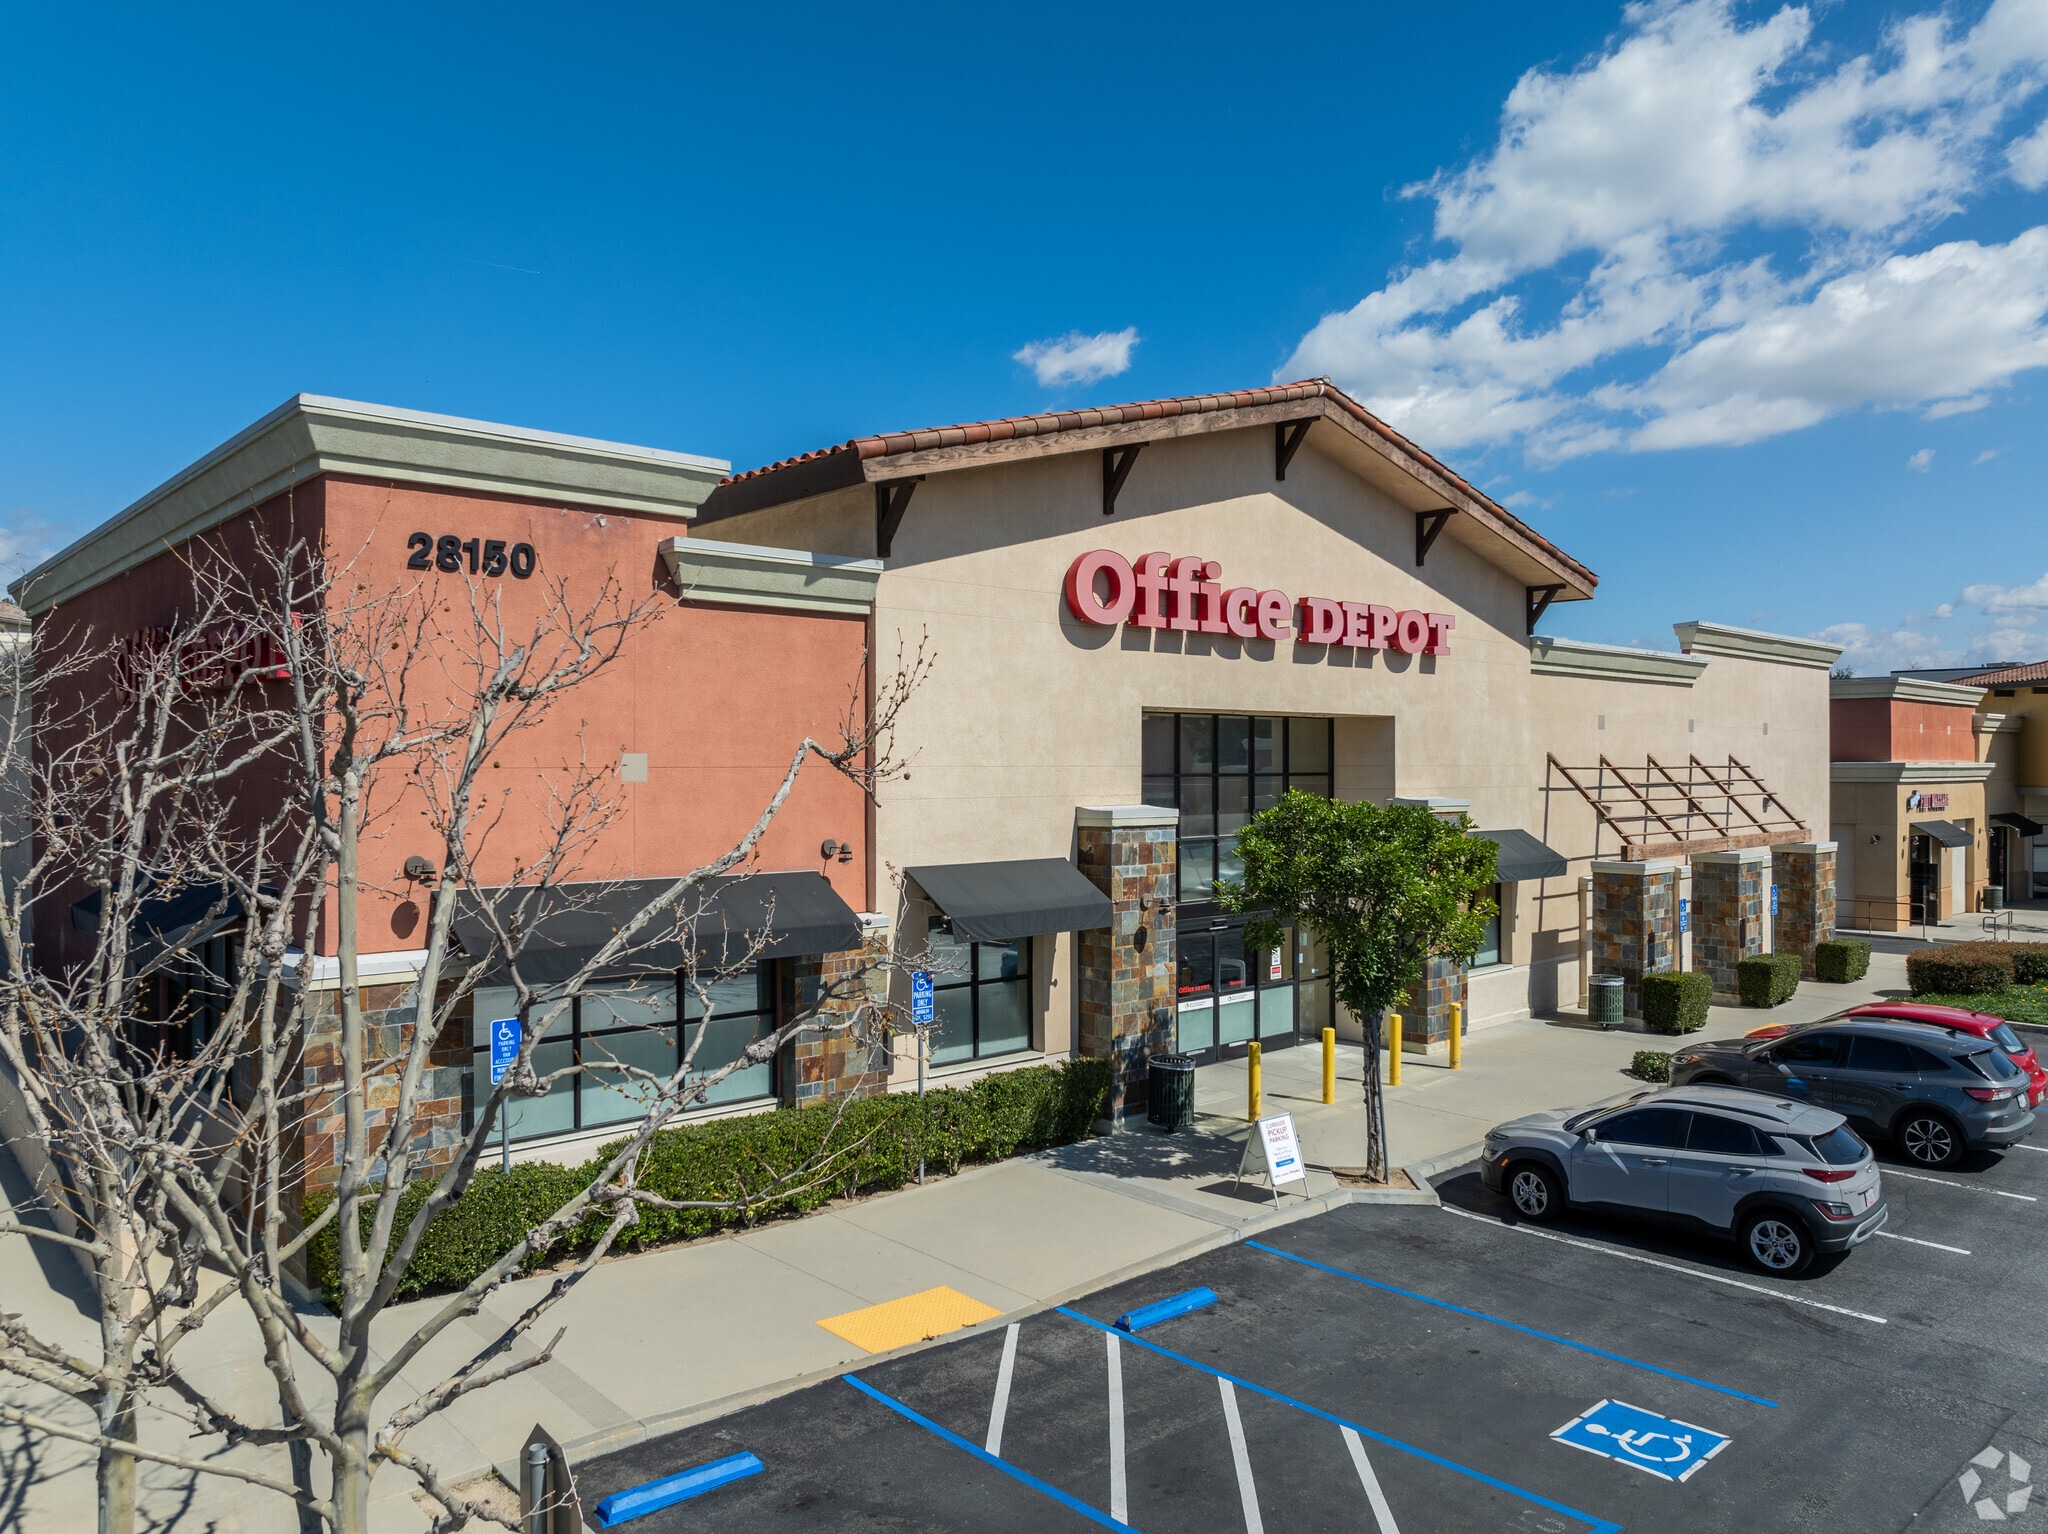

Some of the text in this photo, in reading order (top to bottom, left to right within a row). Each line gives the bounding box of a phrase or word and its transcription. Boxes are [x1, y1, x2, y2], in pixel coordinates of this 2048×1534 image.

[407, 532, 536, 579] 28150
[1066, 549, 1455, 656] Office DEPOT
[913, 990, 932, 999] PARKING
[917, 999, 929, 1007] ONLY
[494, 1057, 514, 1065] ACCESSI
[1265, 1120, 1286, 1130] CURBSIDE
[1267, 1126, 1288, 1137] PICKUP
[1269, 1133, 1290, 1144] PARKING
